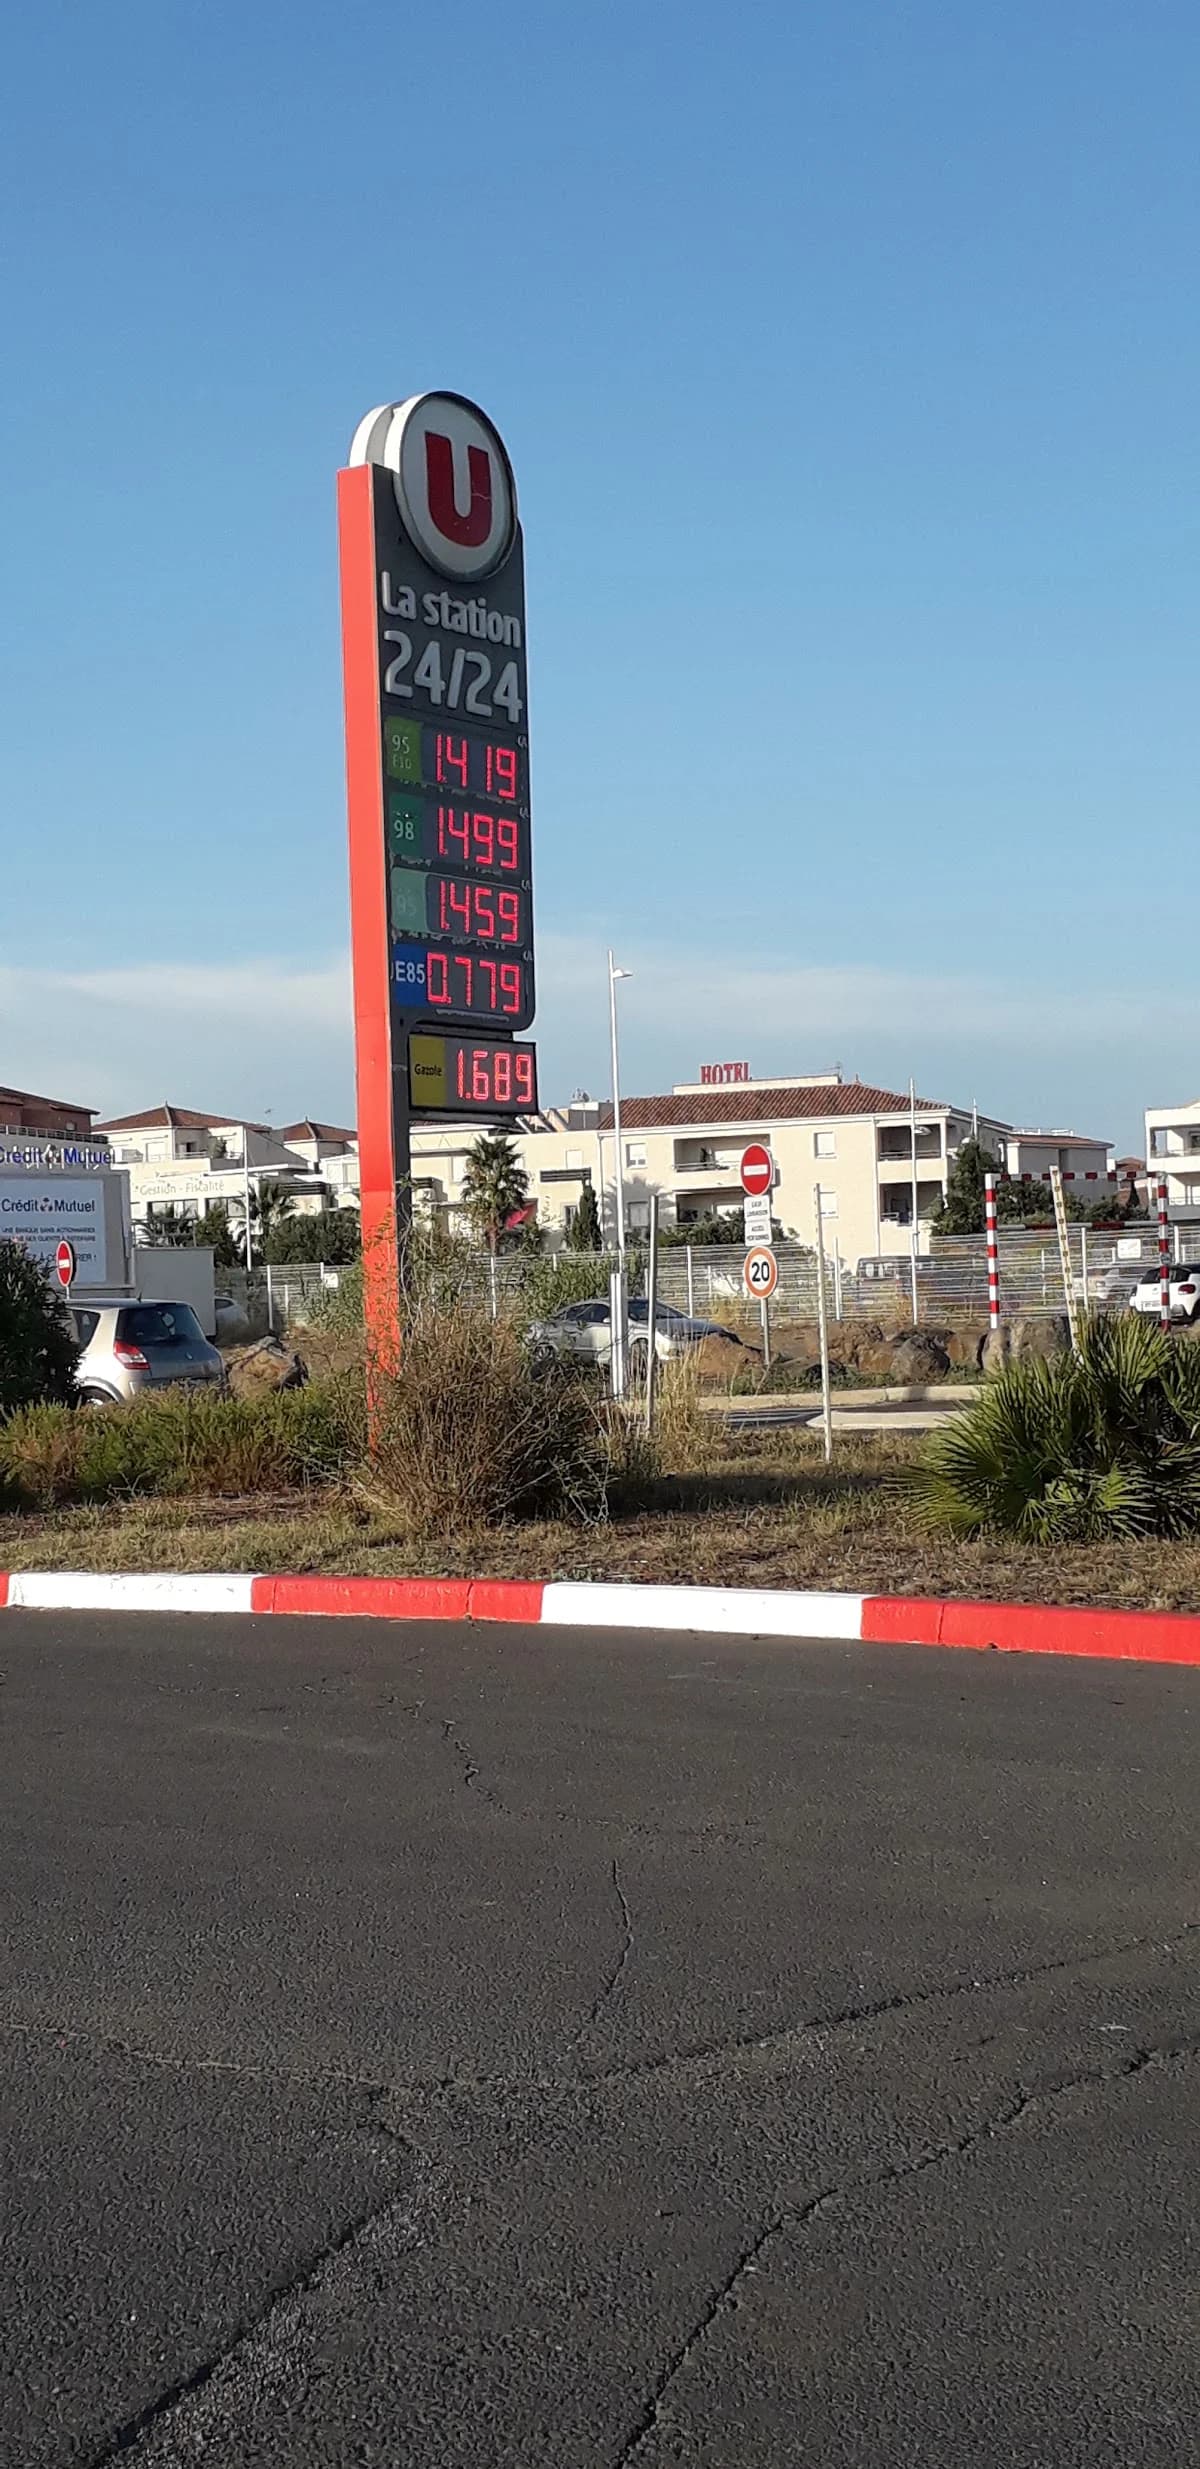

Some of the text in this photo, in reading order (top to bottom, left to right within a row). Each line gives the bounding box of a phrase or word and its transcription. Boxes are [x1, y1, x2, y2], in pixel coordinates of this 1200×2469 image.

[424, 431, 493, 547] U
[381, 571, 522, 648] La station
[383, 629, 523, 724] 24/24
[392, 734, 410, 754] 95
[393, 819, 415, 840] 98
[438, 806, 518, 869] 1.499
[440, 880, 519, 942] 1.459
[395, 960, 426, 984] E85
[426, 952, 520, 1013] 0.779
[414, 1063, 443, 1077] Gazole
[457, 1048, 533, 1103] 1.689
[700, 1062, 752, 1085] HOTEL
[63, 1146, 116, 1165] Mutuel
[140, 1184, 177, 1196] Gestion
[185, 1180, 225, 1193] Fiscalité
[1, 1198, 95, 1212] Crédit Mutuel
[751, 1261, 770, 1282] 20
